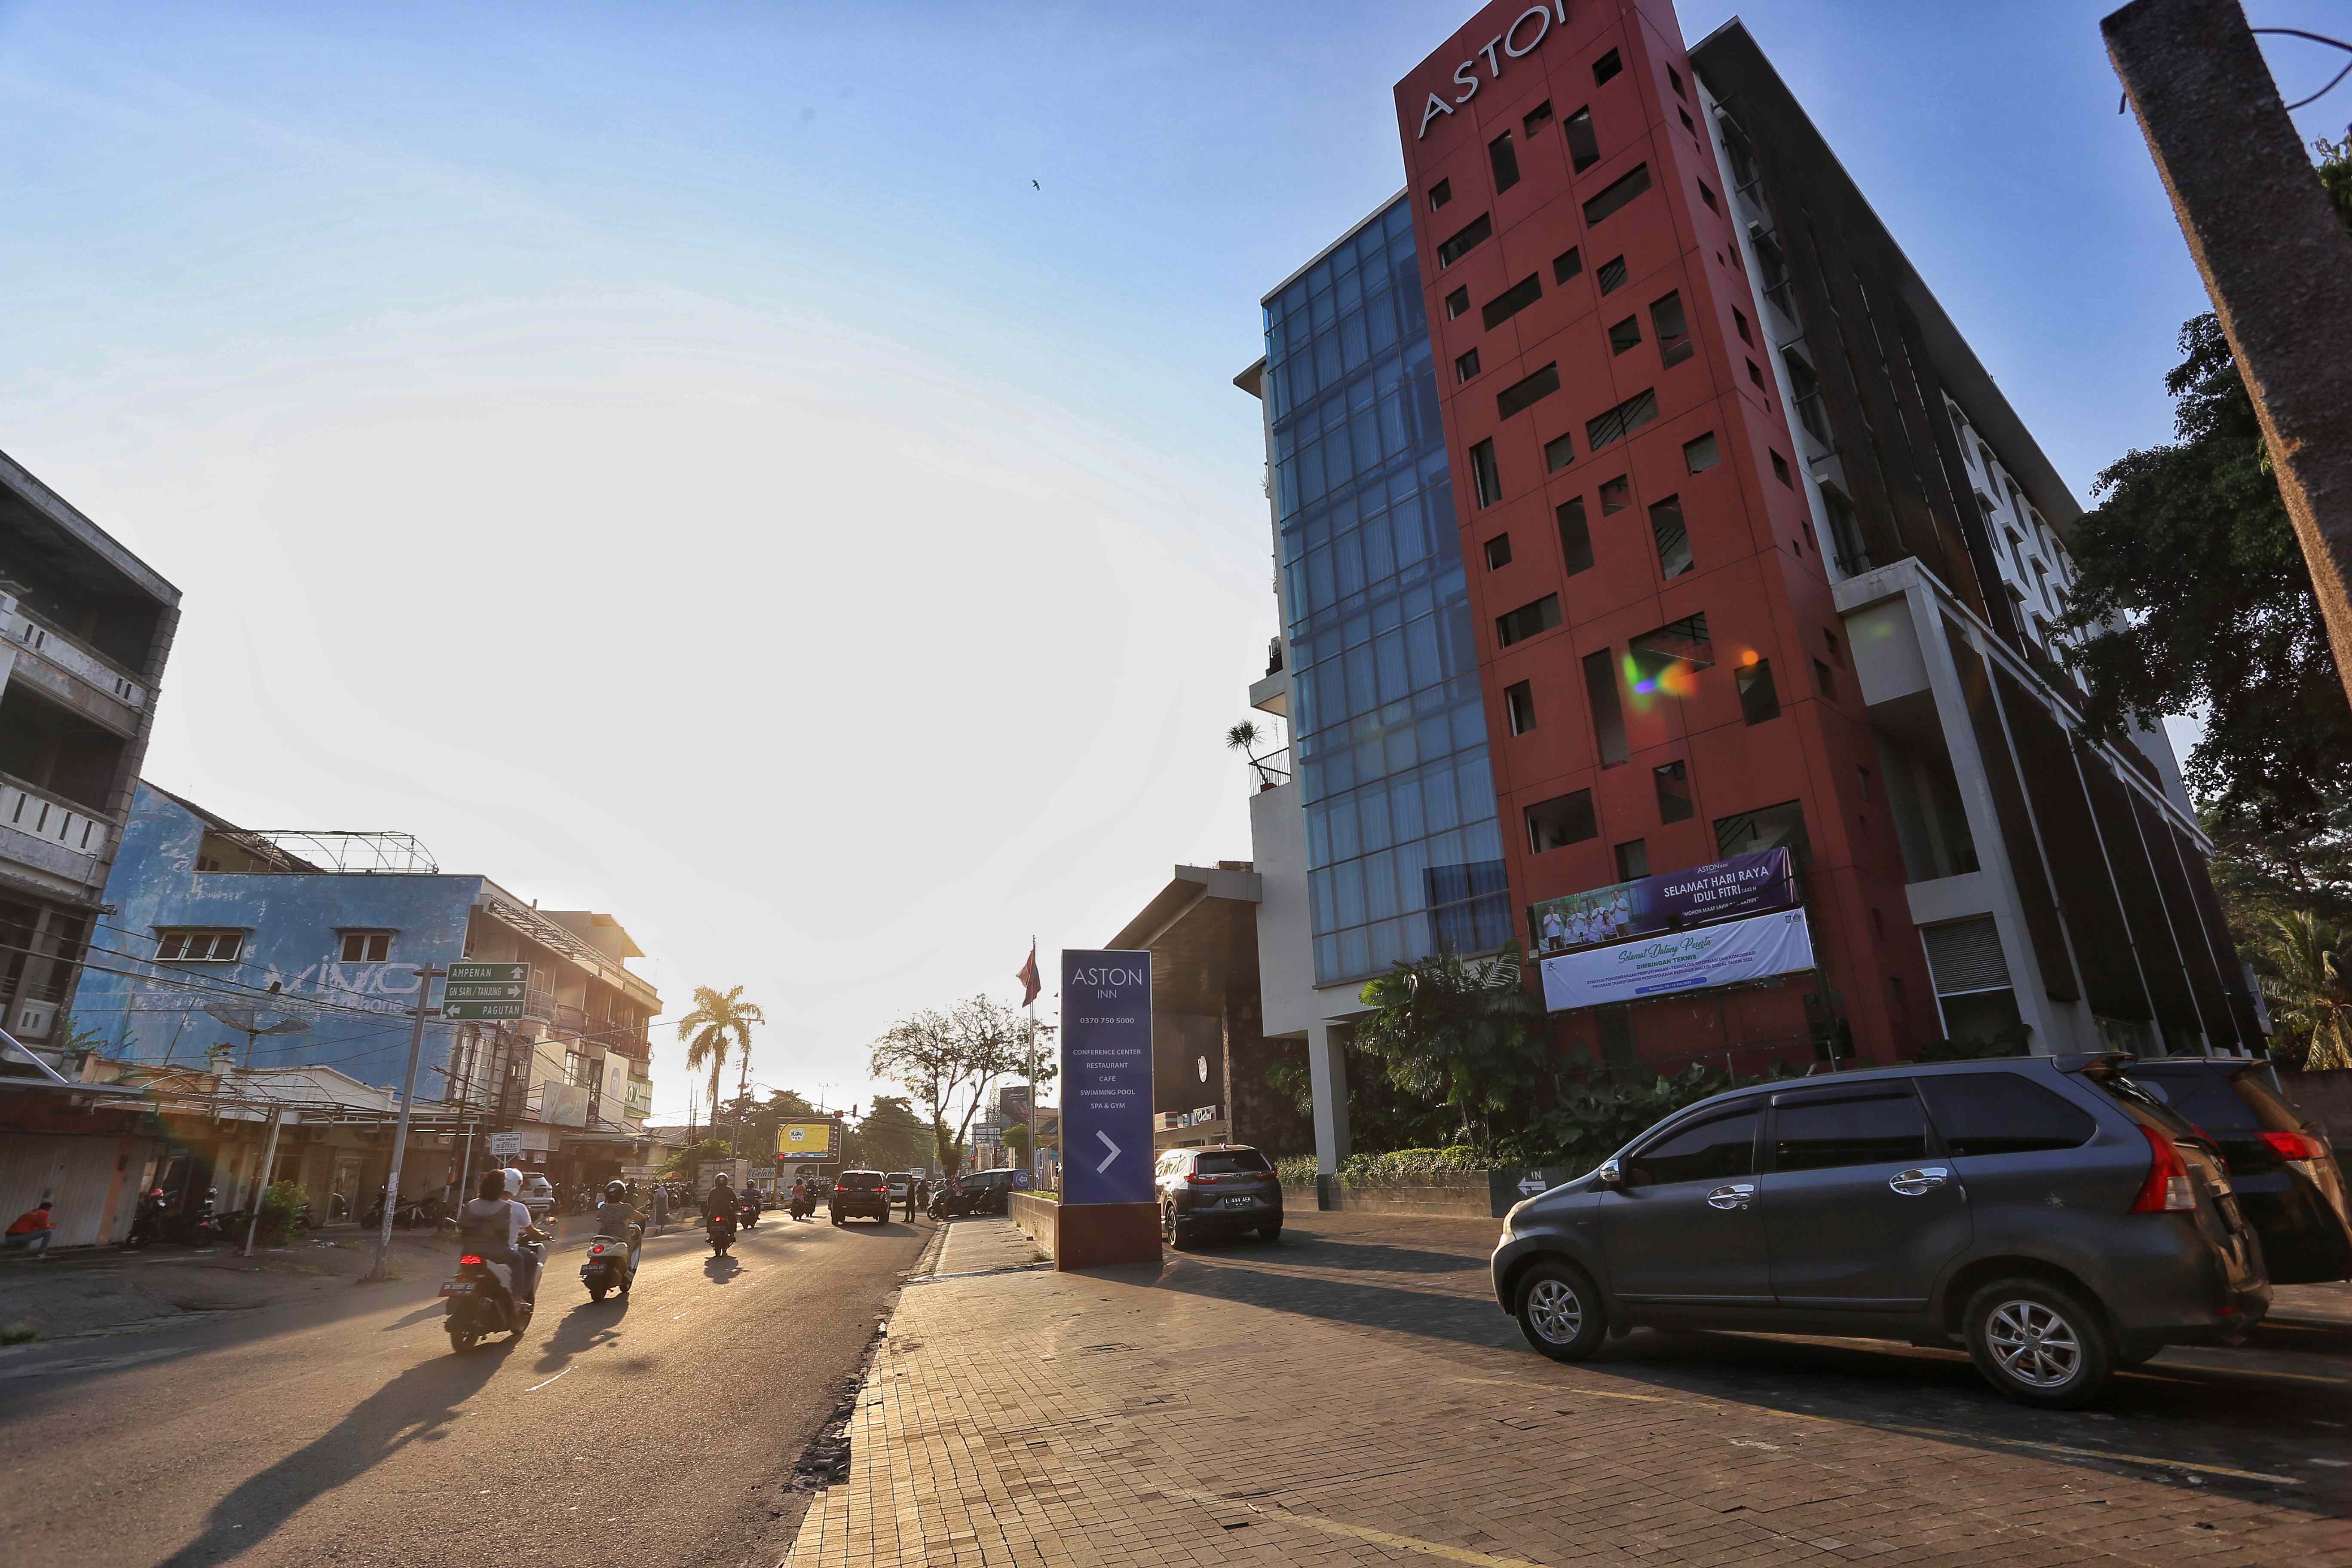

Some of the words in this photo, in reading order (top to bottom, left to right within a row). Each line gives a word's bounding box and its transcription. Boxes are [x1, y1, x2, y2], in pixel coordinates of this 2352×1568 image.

[1697, 863, 1720, 874] ASTON
[1664, 879, 1709, 897] SELAMAT
[1712, 874, 1736, 887] HARI
[1740, 866, 1770, 881] RAYA
[1694, 890, 1717, 903] IDUL
[1718, 884, 1741, 898] FITRI
[1618, 949, 1648, 964] Selamat
[1648, 943, 1678, 958] Datang
[1680, 936, 1712, 951] Peserta
[1605, 972, 1637, 981] PENGEMBANGAN
[1637, 967, 1669, 976] PERPUSTAKAAN
[1695, 958, 1718, 966] INFORMASI
[1728, 951, 1756, 959] KOMUNIKASI
[1636, 959, 1672, 970] BIMBINGAN
[1672, 954, 1697, 963] TEKNIS
[452, 968, 492, 977] AMPENAN
[1072, 968, 1142, 986] ASTON
[1611, 977, 1642, 986] TRANSFORMASI
[1642, 971, 1673, 980] PERPUSTAKAAN
[449, 987, 457, 996] GN
[458, 987, 472, 996] SARI
[478, 987, 502, 996] TANJUNG
[1097, 989, 1117, 998] INN
[482, 1006, 520, 1015] PAGUTAN
[1531, 1171, 1542, 1180] IN
